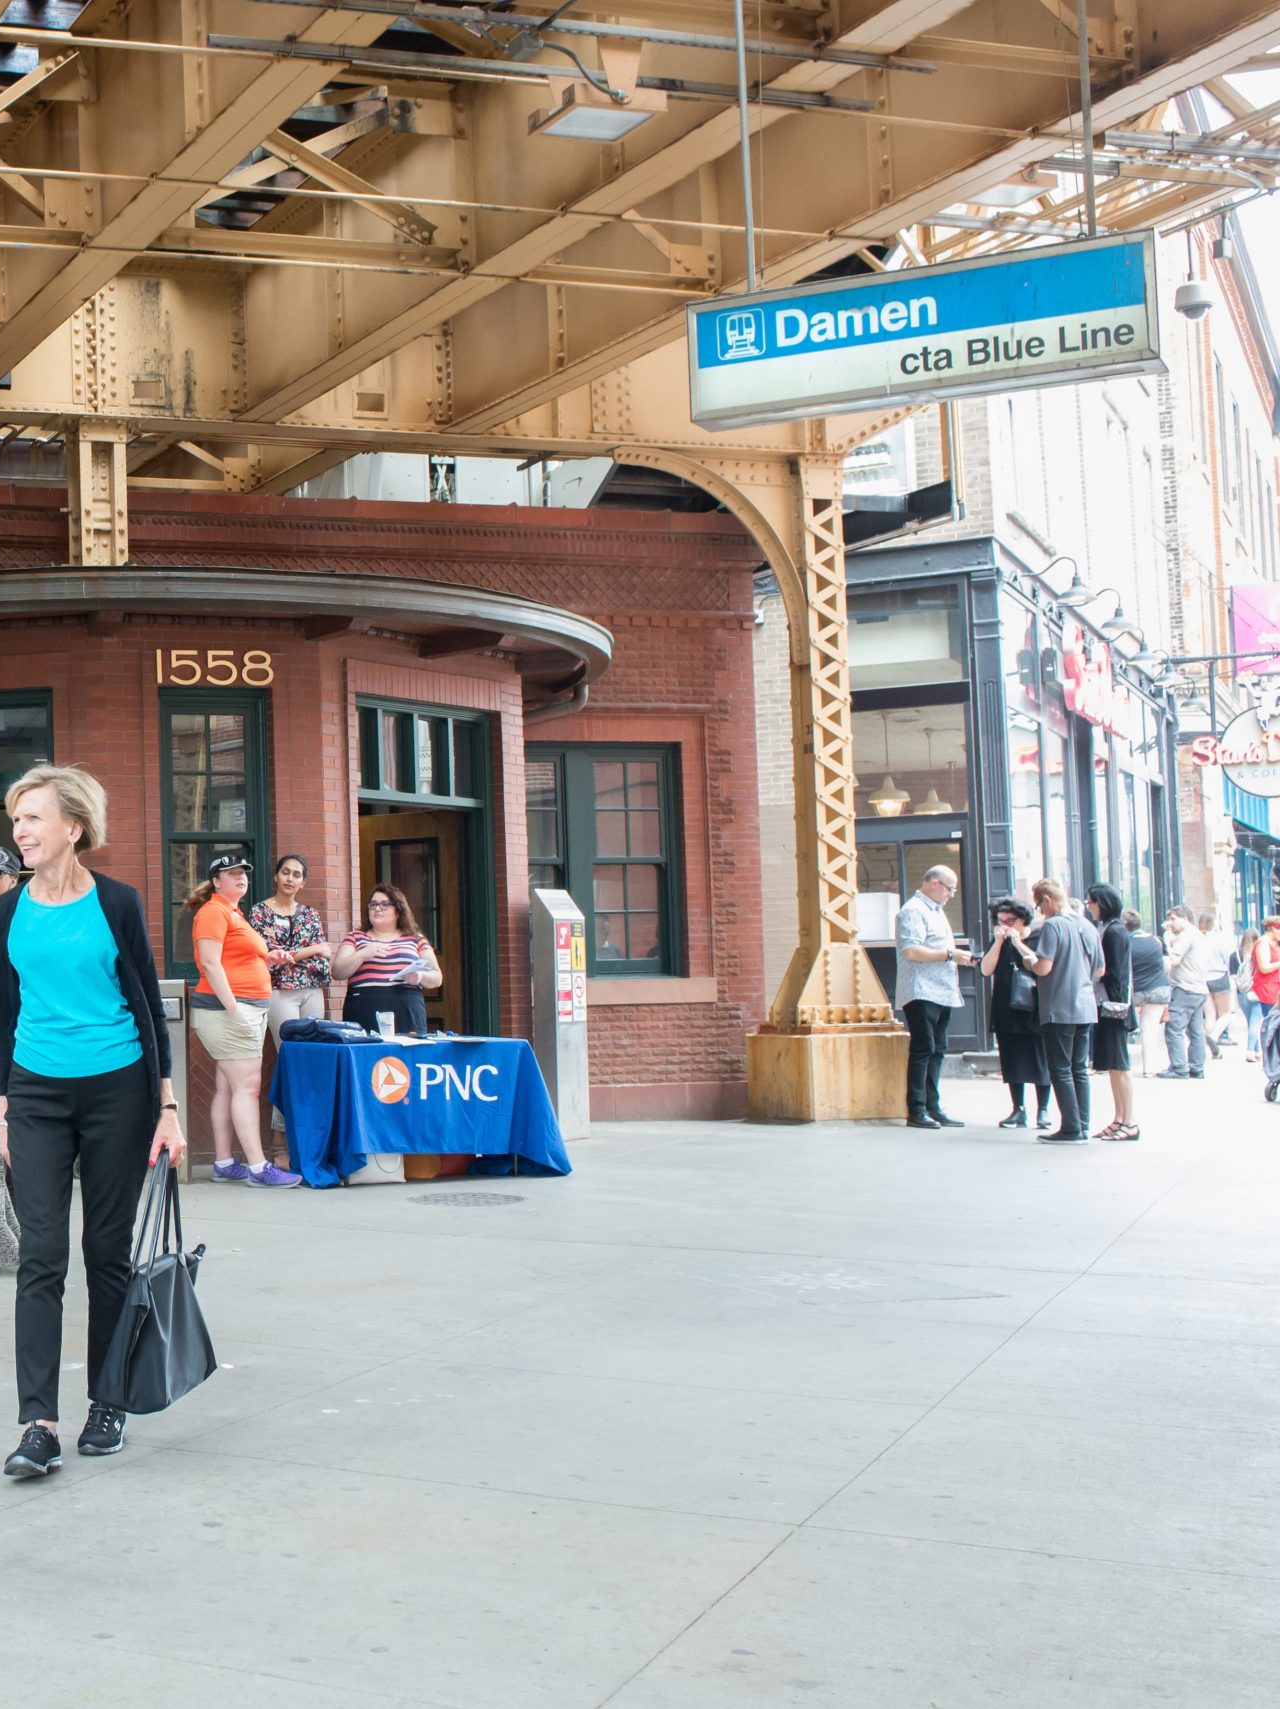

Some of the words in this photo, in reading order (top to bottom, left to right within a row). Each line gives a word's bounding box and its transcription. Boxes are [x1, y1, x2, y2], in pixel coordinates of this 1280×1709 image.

[775, 295, 938, 348] Damen
[900, 346, 953, 375] cta
[967, 329, 1045, 366] Blue
[1059, 323, 1135, 354] Line
[156, 649, 274, 686] 1558
[416, 1063, 498, 1101] PNC
